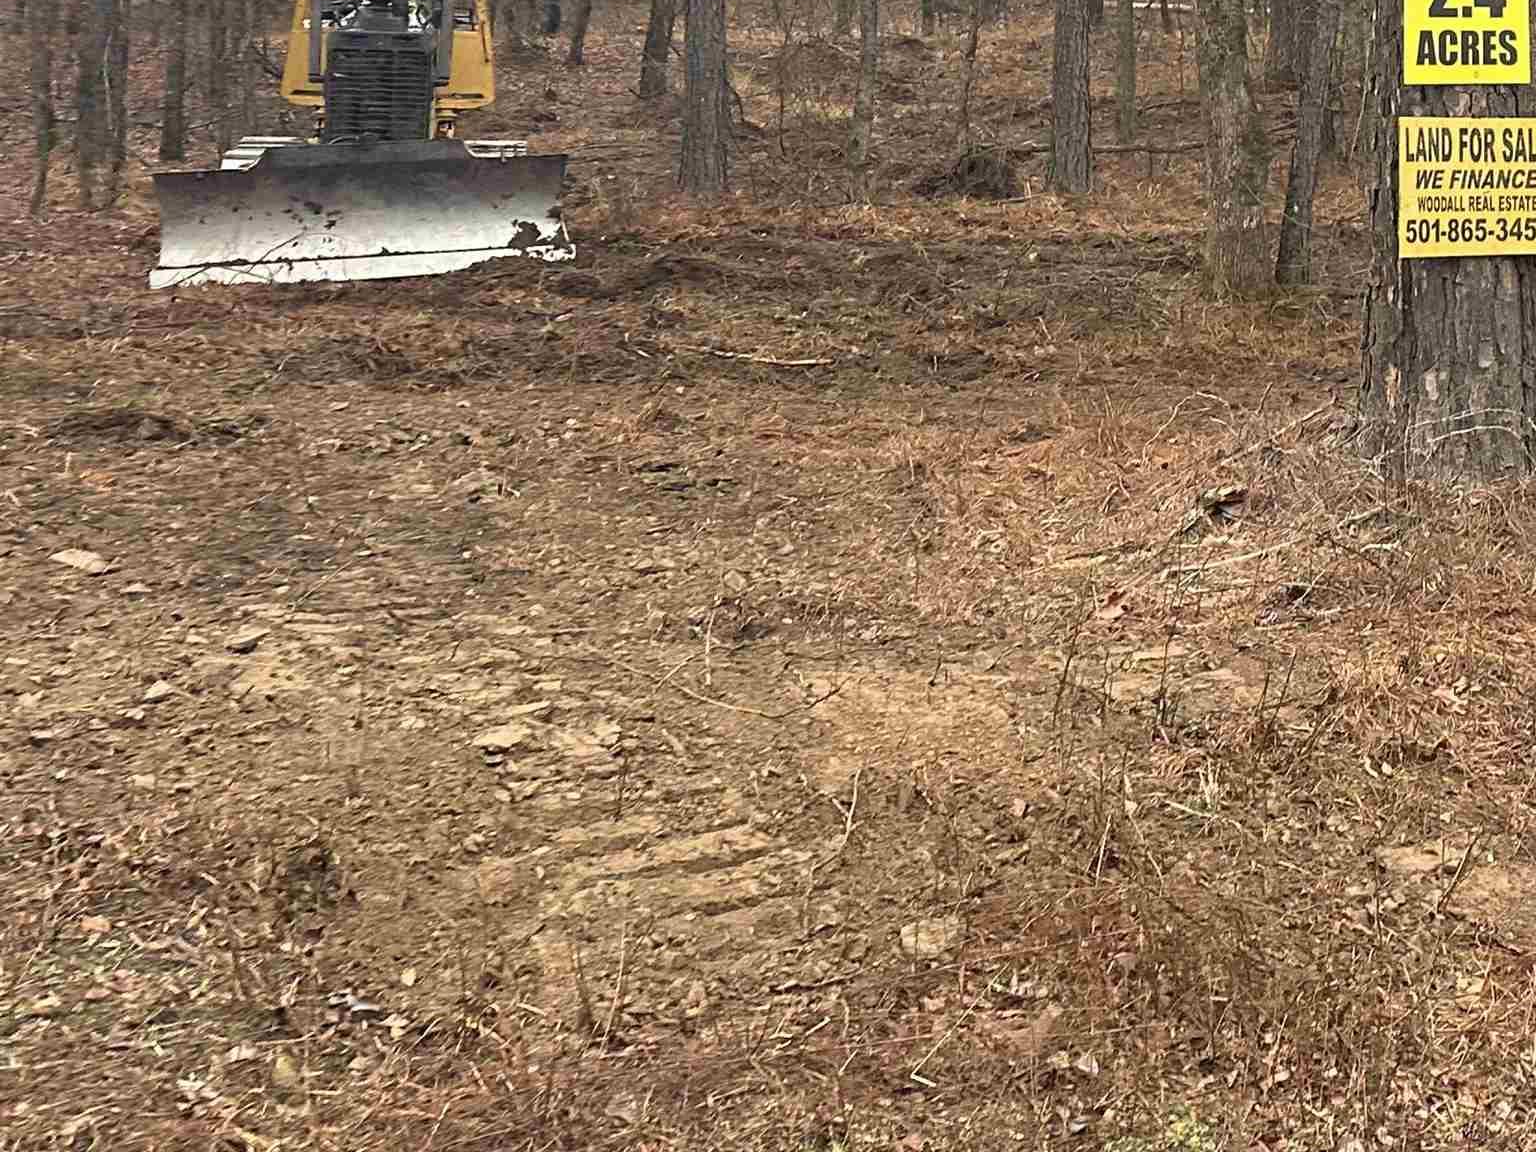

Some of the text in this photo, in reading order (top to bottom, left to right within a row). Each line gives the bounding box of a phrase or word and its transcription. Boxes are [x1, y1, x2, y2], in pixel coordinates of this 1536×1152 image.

[1416, 29, 1518, 66] ACRES
[1405, 127, 1453, 162] LAND
[1459, 128, 1496, 162] FOR
[1415, 169, 1445, 189] WE
[1417, 196, 1465, 212] WOODALL
[1469, 196, 1495, 212] REAL
